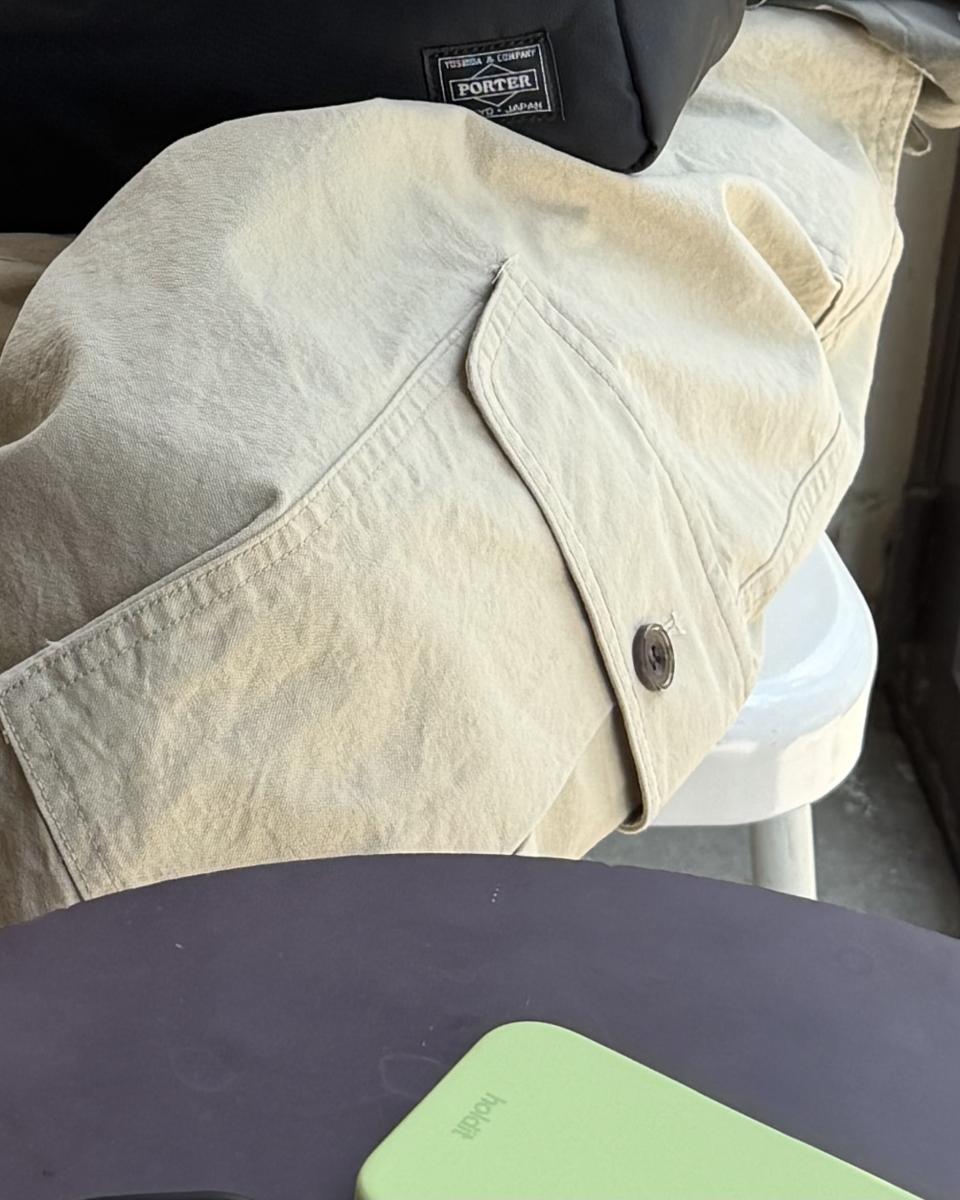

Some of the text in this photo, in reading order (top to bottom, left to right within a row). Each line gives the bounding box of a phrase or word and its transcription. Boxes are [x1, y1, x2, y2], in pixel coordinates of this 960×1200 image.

[497, 49, 536, 63] COMPANY
[457, 74, 532, 97] PORTER
[505, 101, 543, 114] JAPAN
